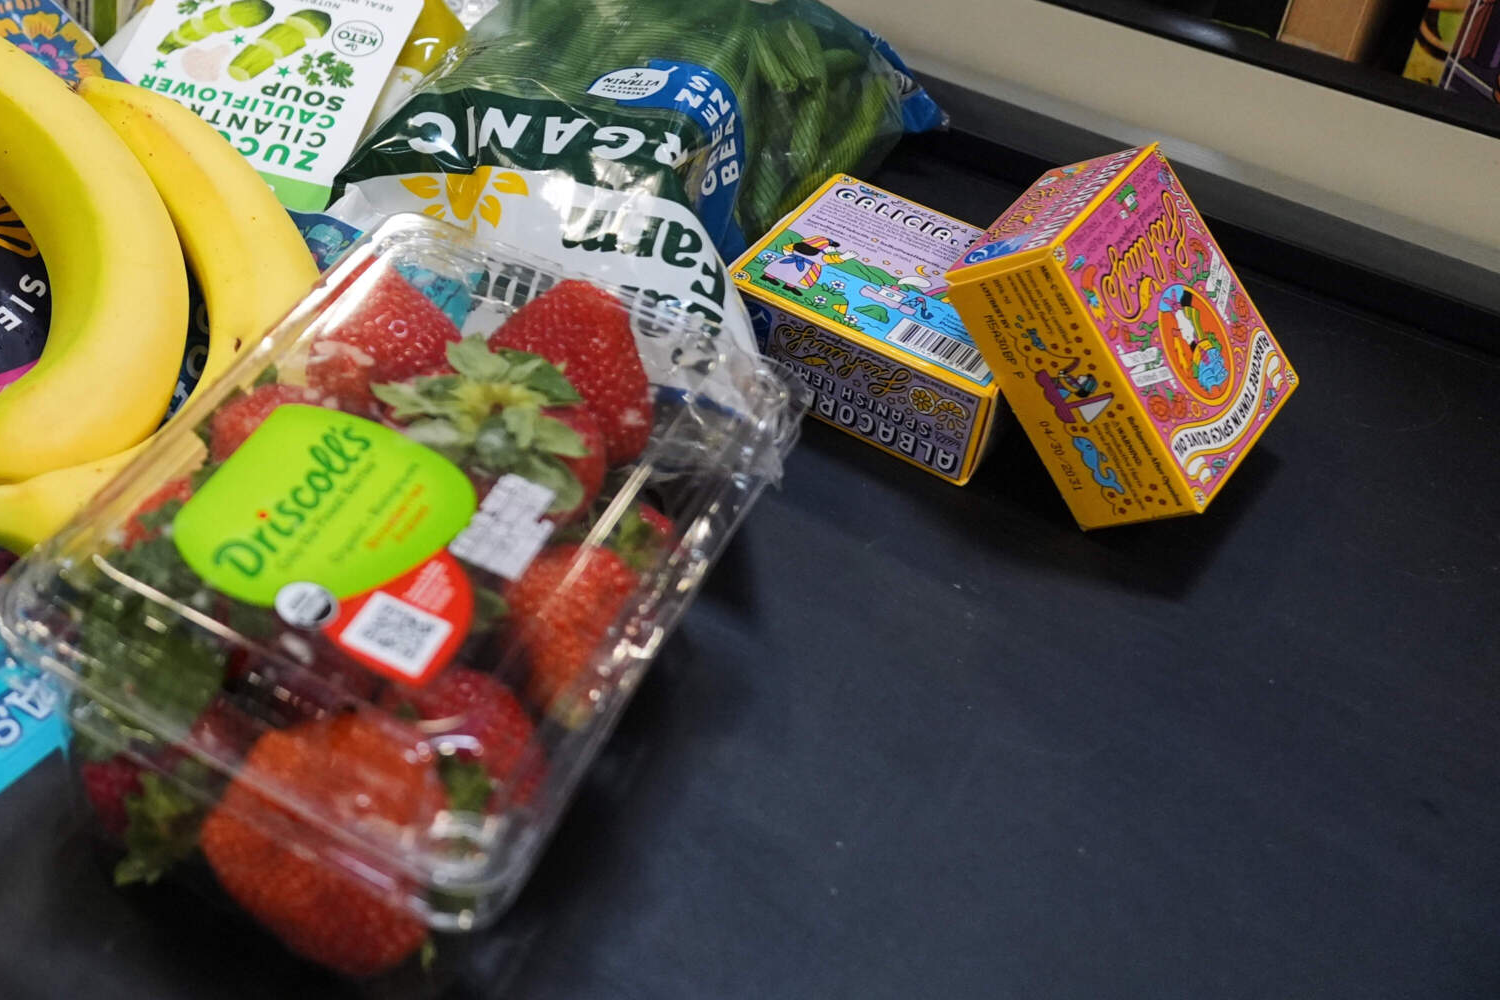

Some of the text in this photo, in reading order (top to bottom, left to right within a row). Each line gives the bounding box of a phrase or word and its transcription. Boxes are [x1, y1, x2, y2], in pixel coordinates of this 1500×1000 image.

[336, 29, 378, 47] KETO
[138, 72, 335, 130] CAULIFLOWER
[258, 79, 345, 113] SOUP
[601, 87, 645, 95] EXCELLENT
[603, 76, 659, 87] VITAMIN
[630, 70, 643, 79] K
[408, 105, 688, 167] RGANIC
[674, 87, 722, 195] GREEN
[686, 74, 739, 185] BEANS
[1022, 212, 1073, 250] TUNA
[1102, 190, 1188, 322] Fishwife
[977, 280, 1012, 332] LOT/BEST BY
[1013, 271, 1042, 312] sustainable
[774, 324, 911, 395] Fishwife
[837, 385, 934, 439] SPANISH
[1171, 335, 1270, 455] ALBACORE TUNA IN SPICY OLIVE OIL
[1036, 418, 1084, 494] 04/30/2031
[1100, 419, 1145, 489] Reproductive Harm
[1114, 425, 1144, 469] WARNING:
[1124, 413, 1155, 458] Refrigerate
[1148, 454, 1167, 478] After
[1158, 474, 1186, 509] Opening
[212, 421, 375, 583] Driscoll's
